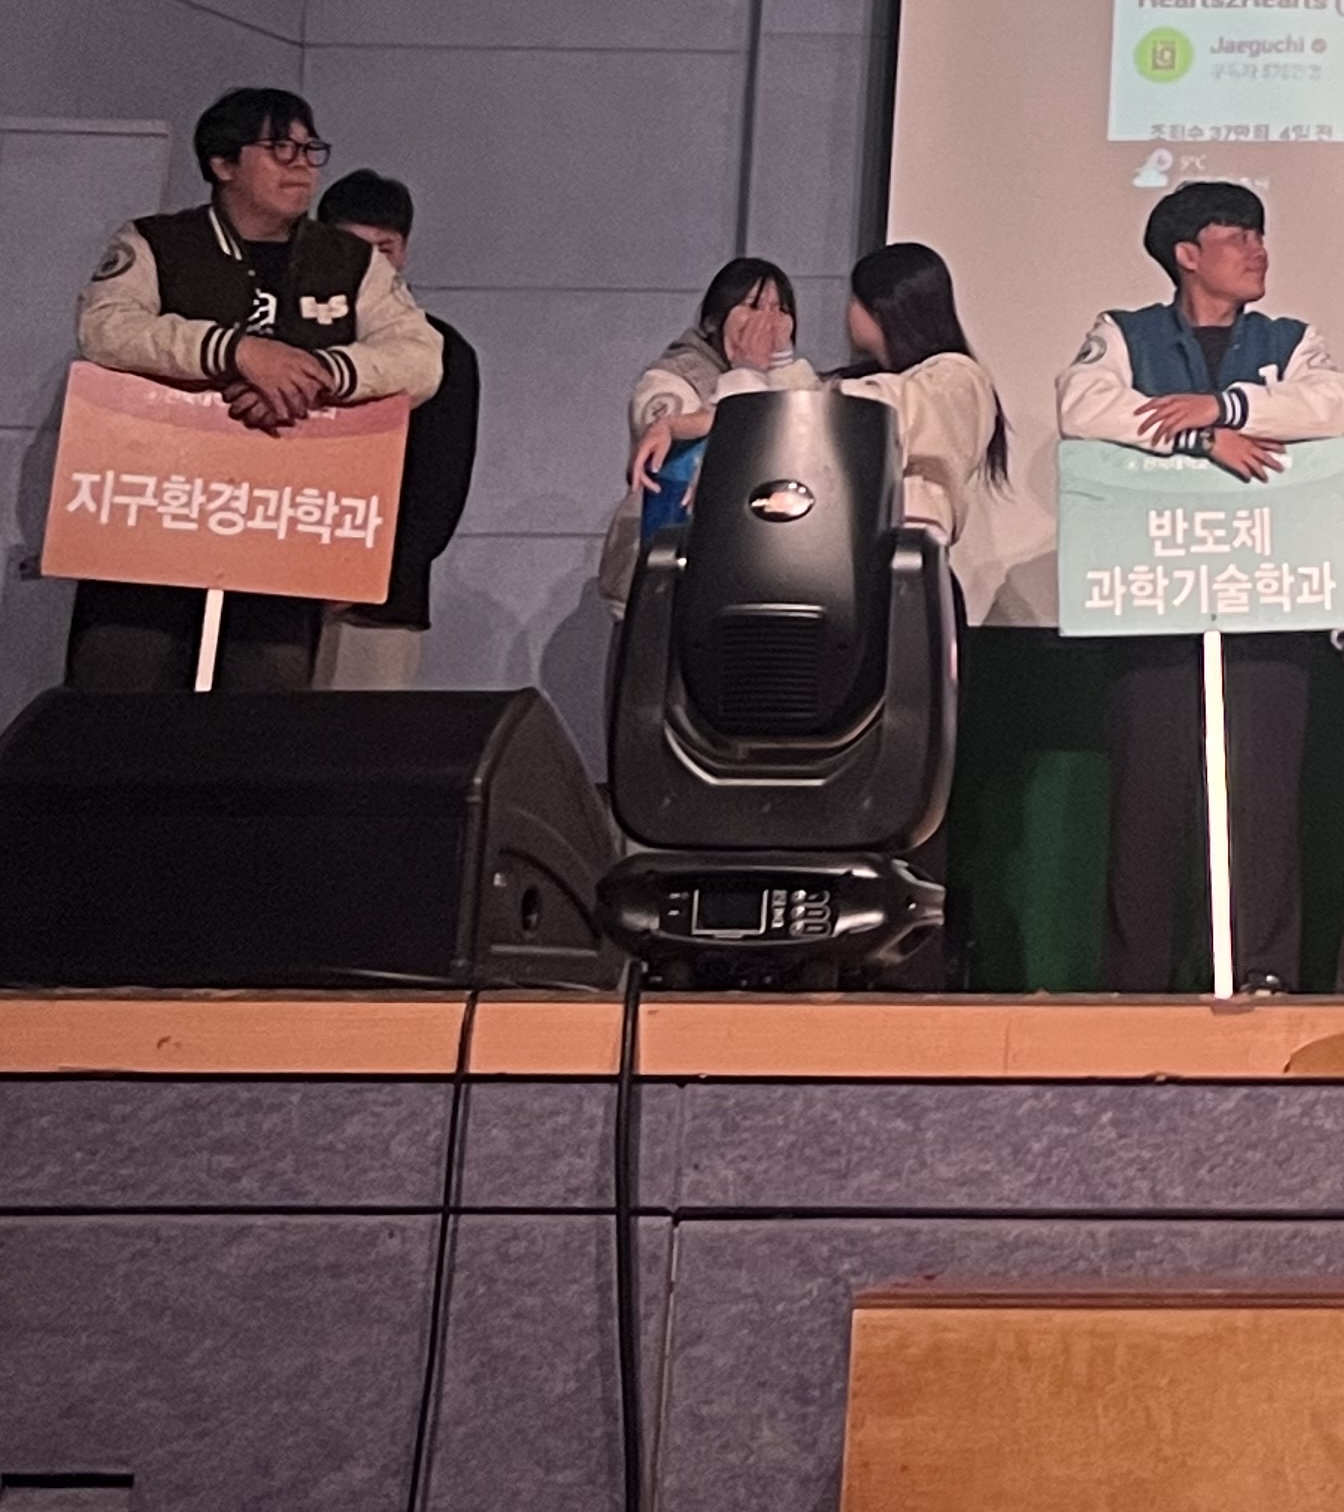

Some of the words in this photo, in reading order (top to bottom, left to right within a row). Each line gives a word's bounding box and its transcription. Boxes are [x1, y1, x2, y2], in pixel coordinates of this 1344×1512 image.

[1209, 35, 1305, 57] Jaeguchi
[66, 470, 384, 549] 지구환경과학과
[1147, 507, 1273, 557] 반도체
[1084, 560, 1338, 617] 과학기술학과
